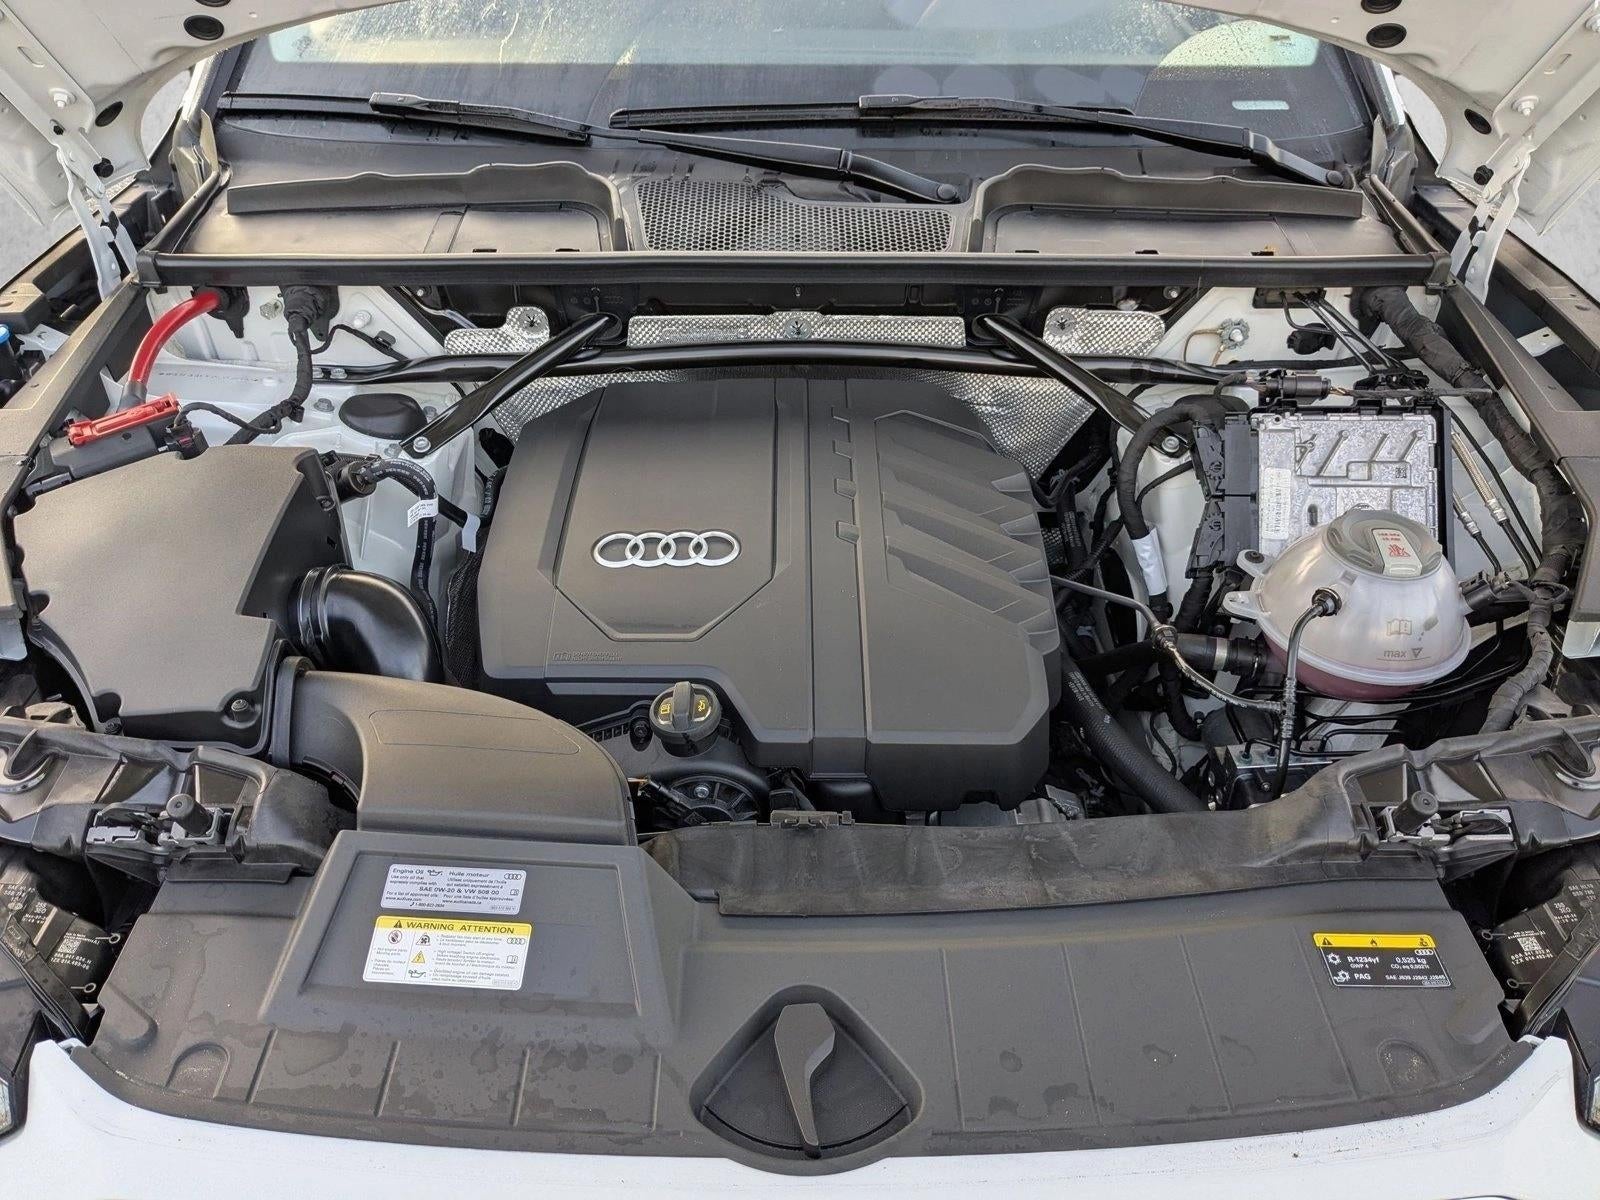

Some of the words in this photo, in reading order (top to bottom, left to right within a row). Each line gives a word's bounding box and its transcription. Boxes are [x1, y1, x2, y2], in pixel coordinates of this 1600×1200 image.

[1384, 650, 1407, 658] max
[407, 922, 454, 931] WARNING
[460, 924, 515, 934] ATTENTION
[1347, 956, 1379, 964] R-1234yf
